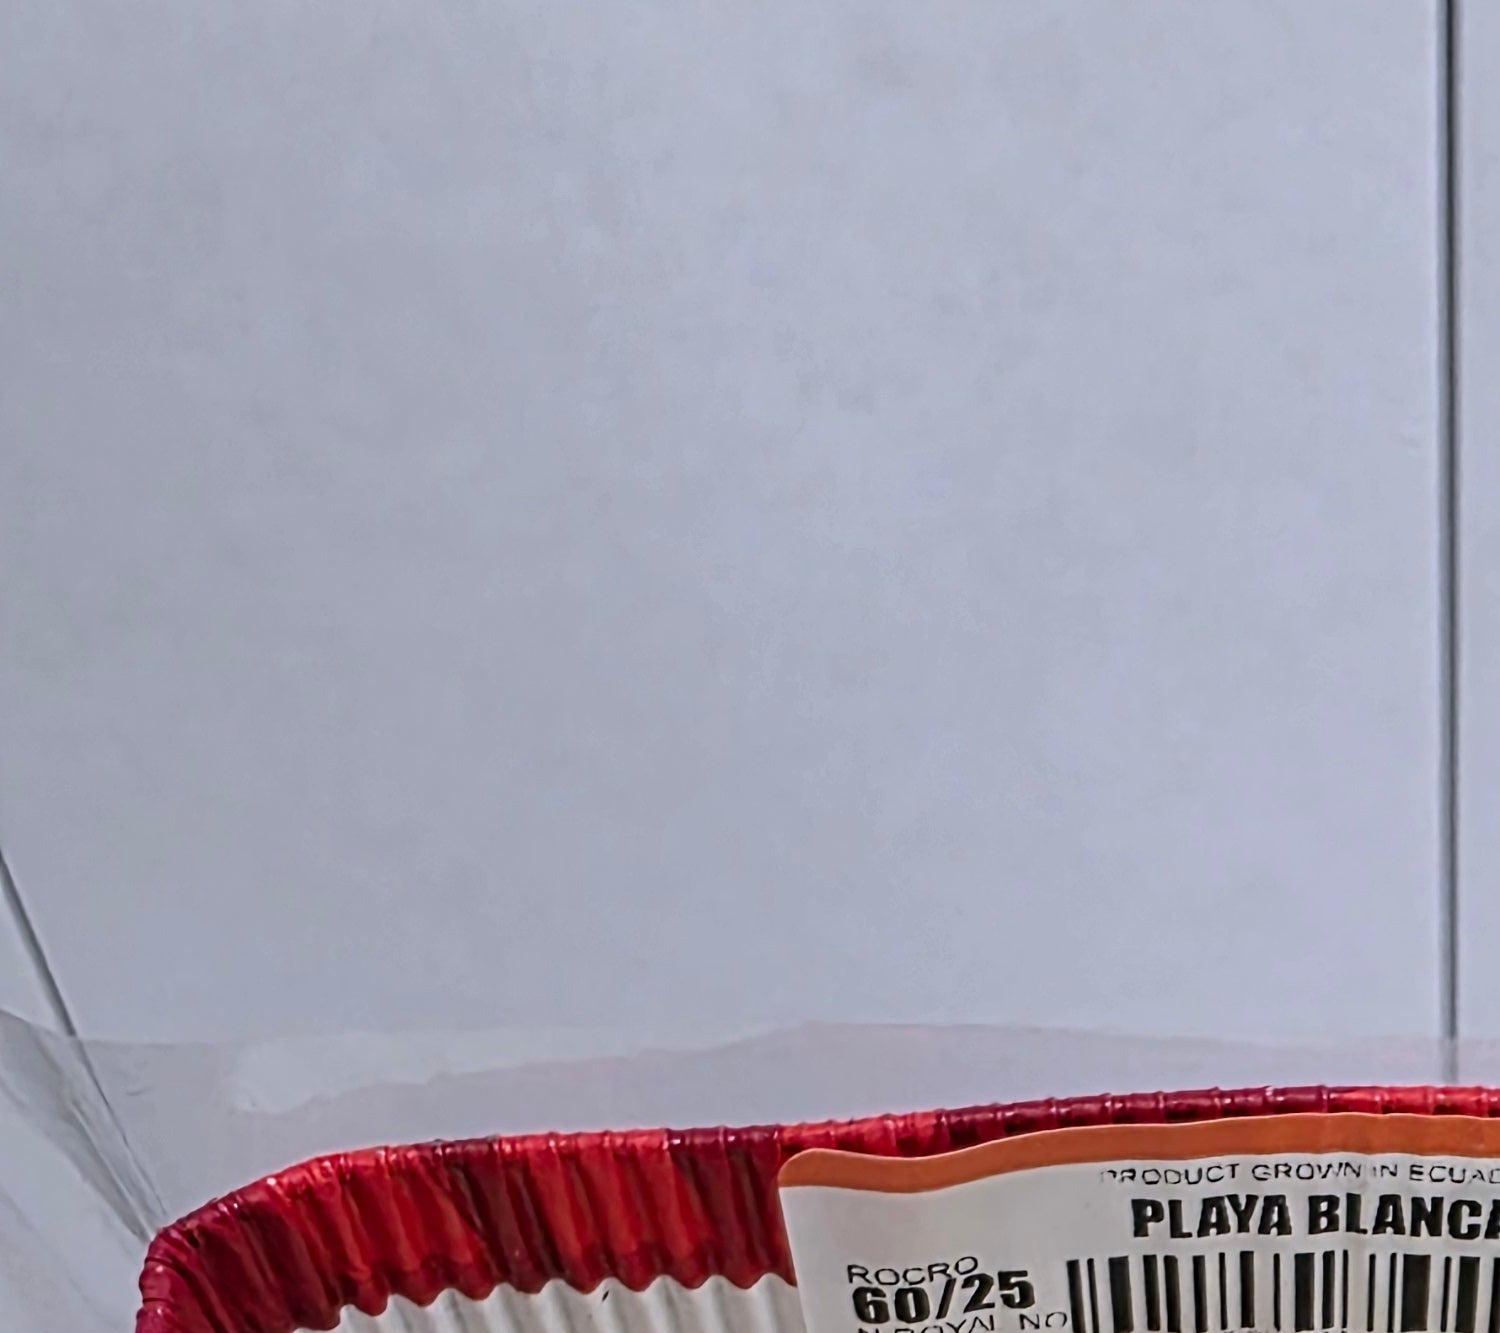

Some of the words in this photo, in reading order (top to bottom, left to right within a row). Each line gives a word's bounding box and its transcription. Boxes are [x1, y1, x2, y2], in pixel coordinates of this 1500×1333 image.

[1100, 1163, 1240, 1185] PRODUCT
[1252, 1162, 1361, 1180] GROWN
[1373, 1164, 1398, 1177] IN
[1131, 1194, 1292, 1239] PLAYA
[852, 1270, 1035, 1324] 60/25
